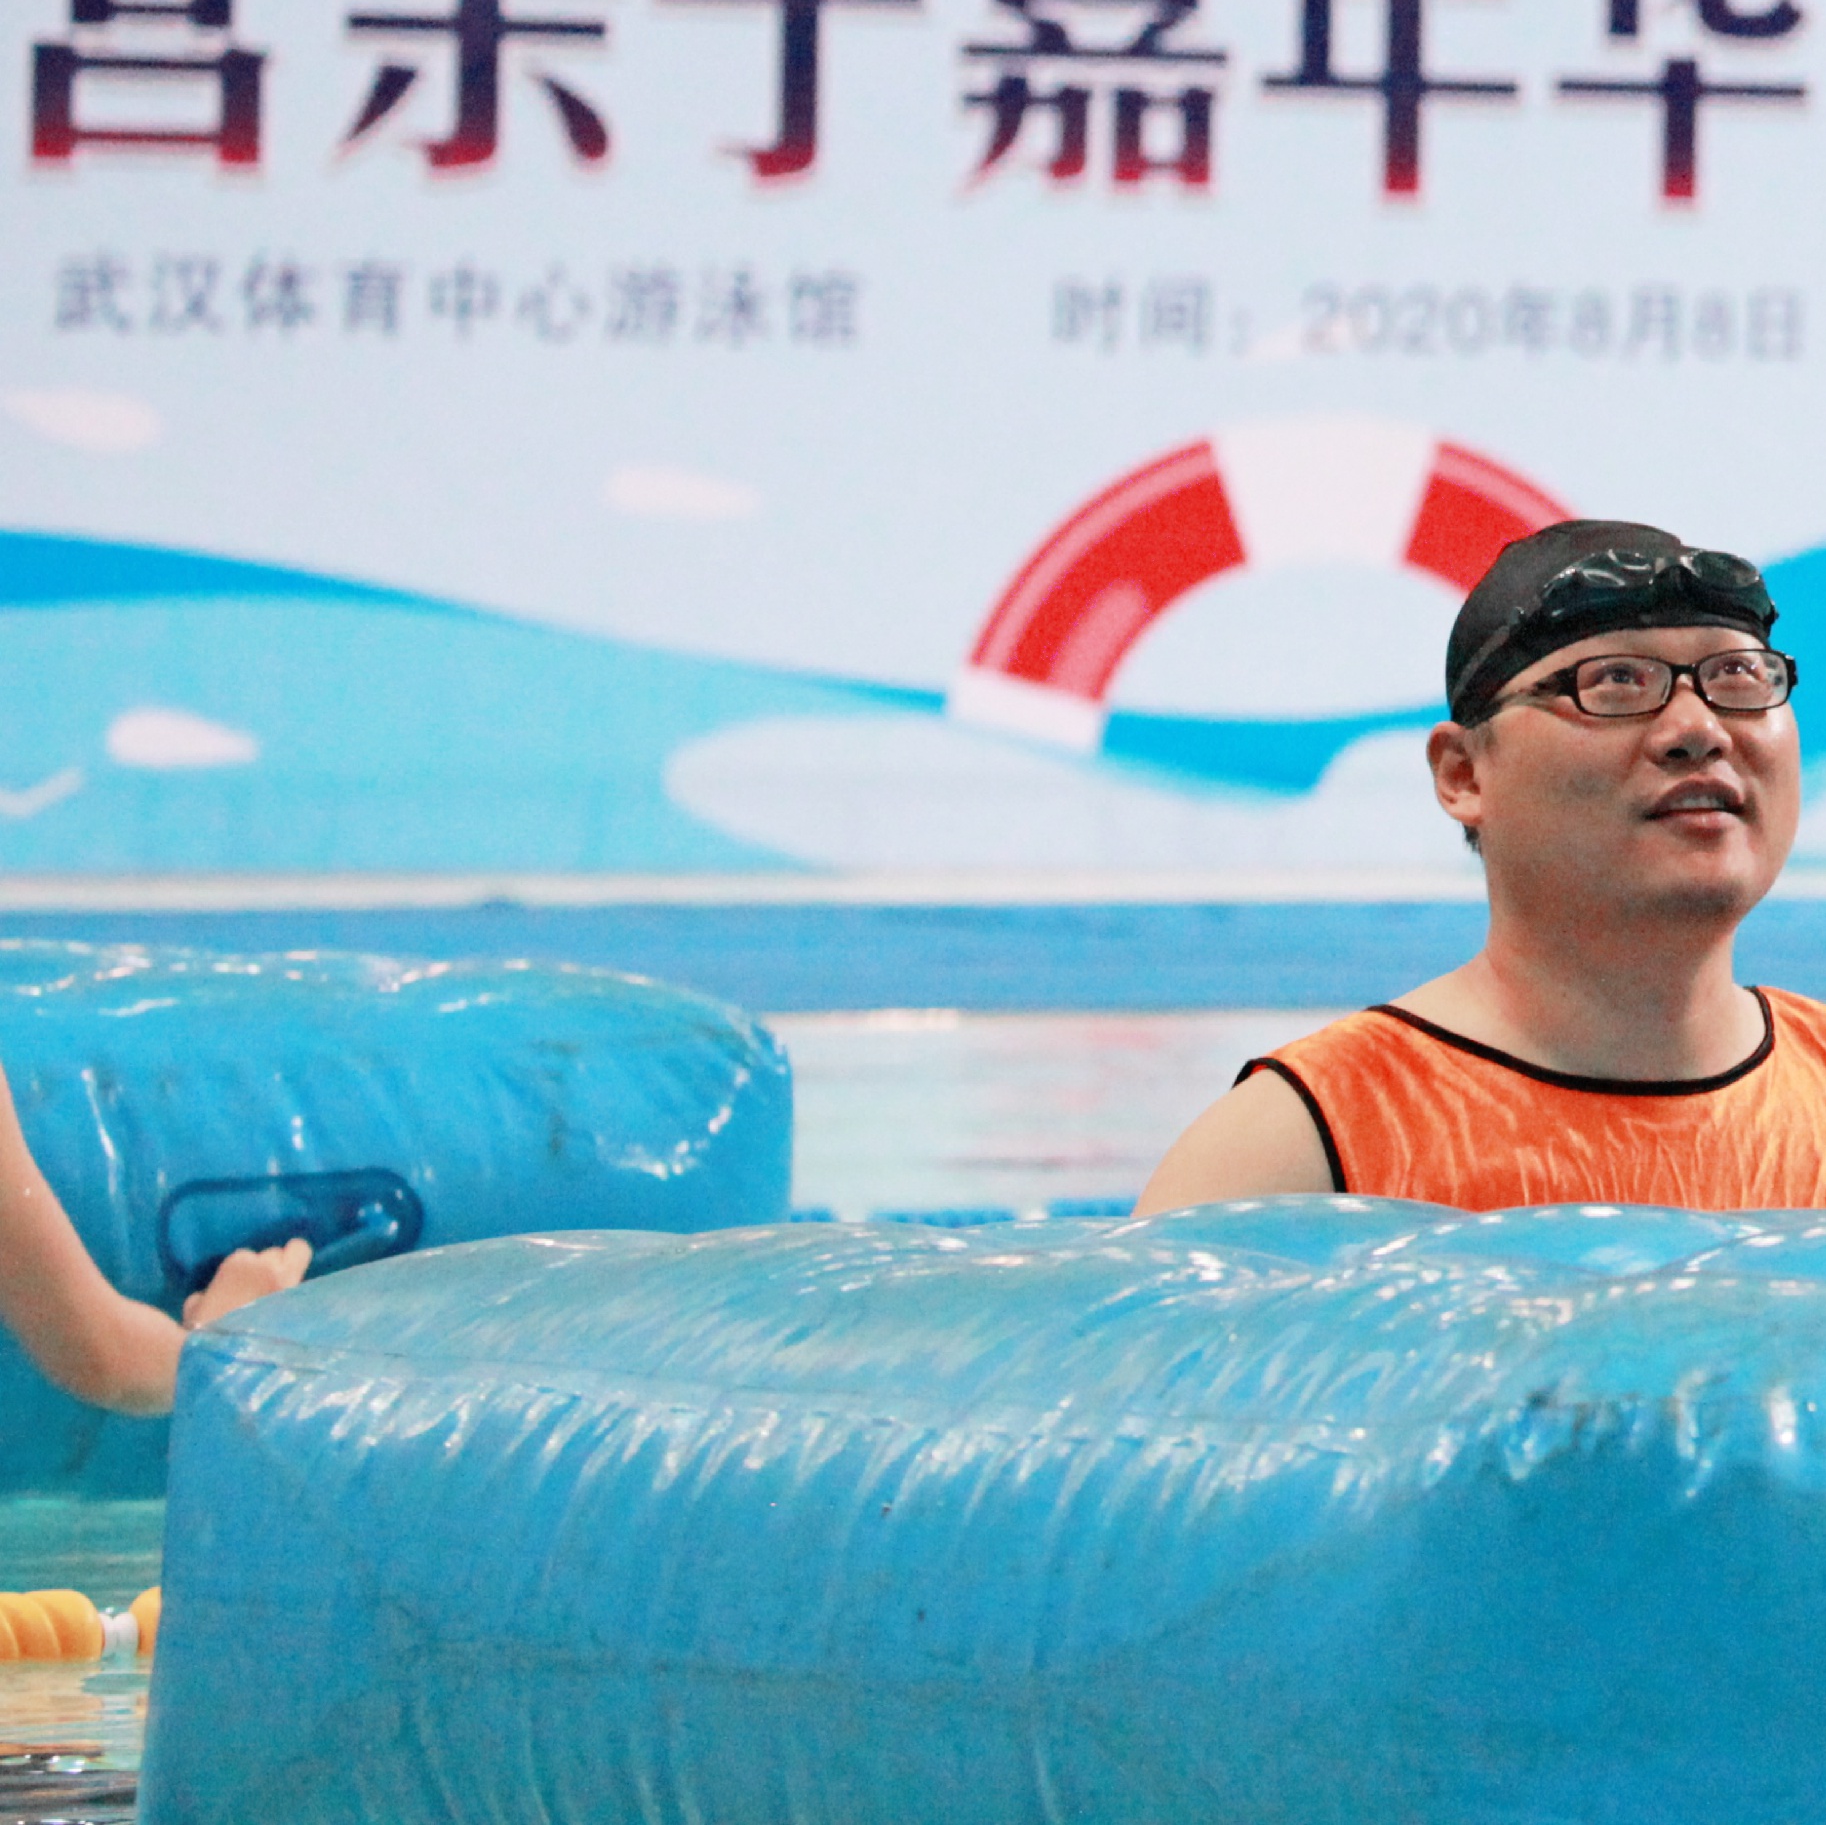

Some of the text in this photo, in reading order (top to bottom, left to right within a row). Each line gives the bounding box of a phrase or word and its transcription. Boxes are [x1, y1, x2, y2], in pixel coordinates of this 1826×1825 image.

[54, 250, 864, 346] 武汉体育中心游泳馆
